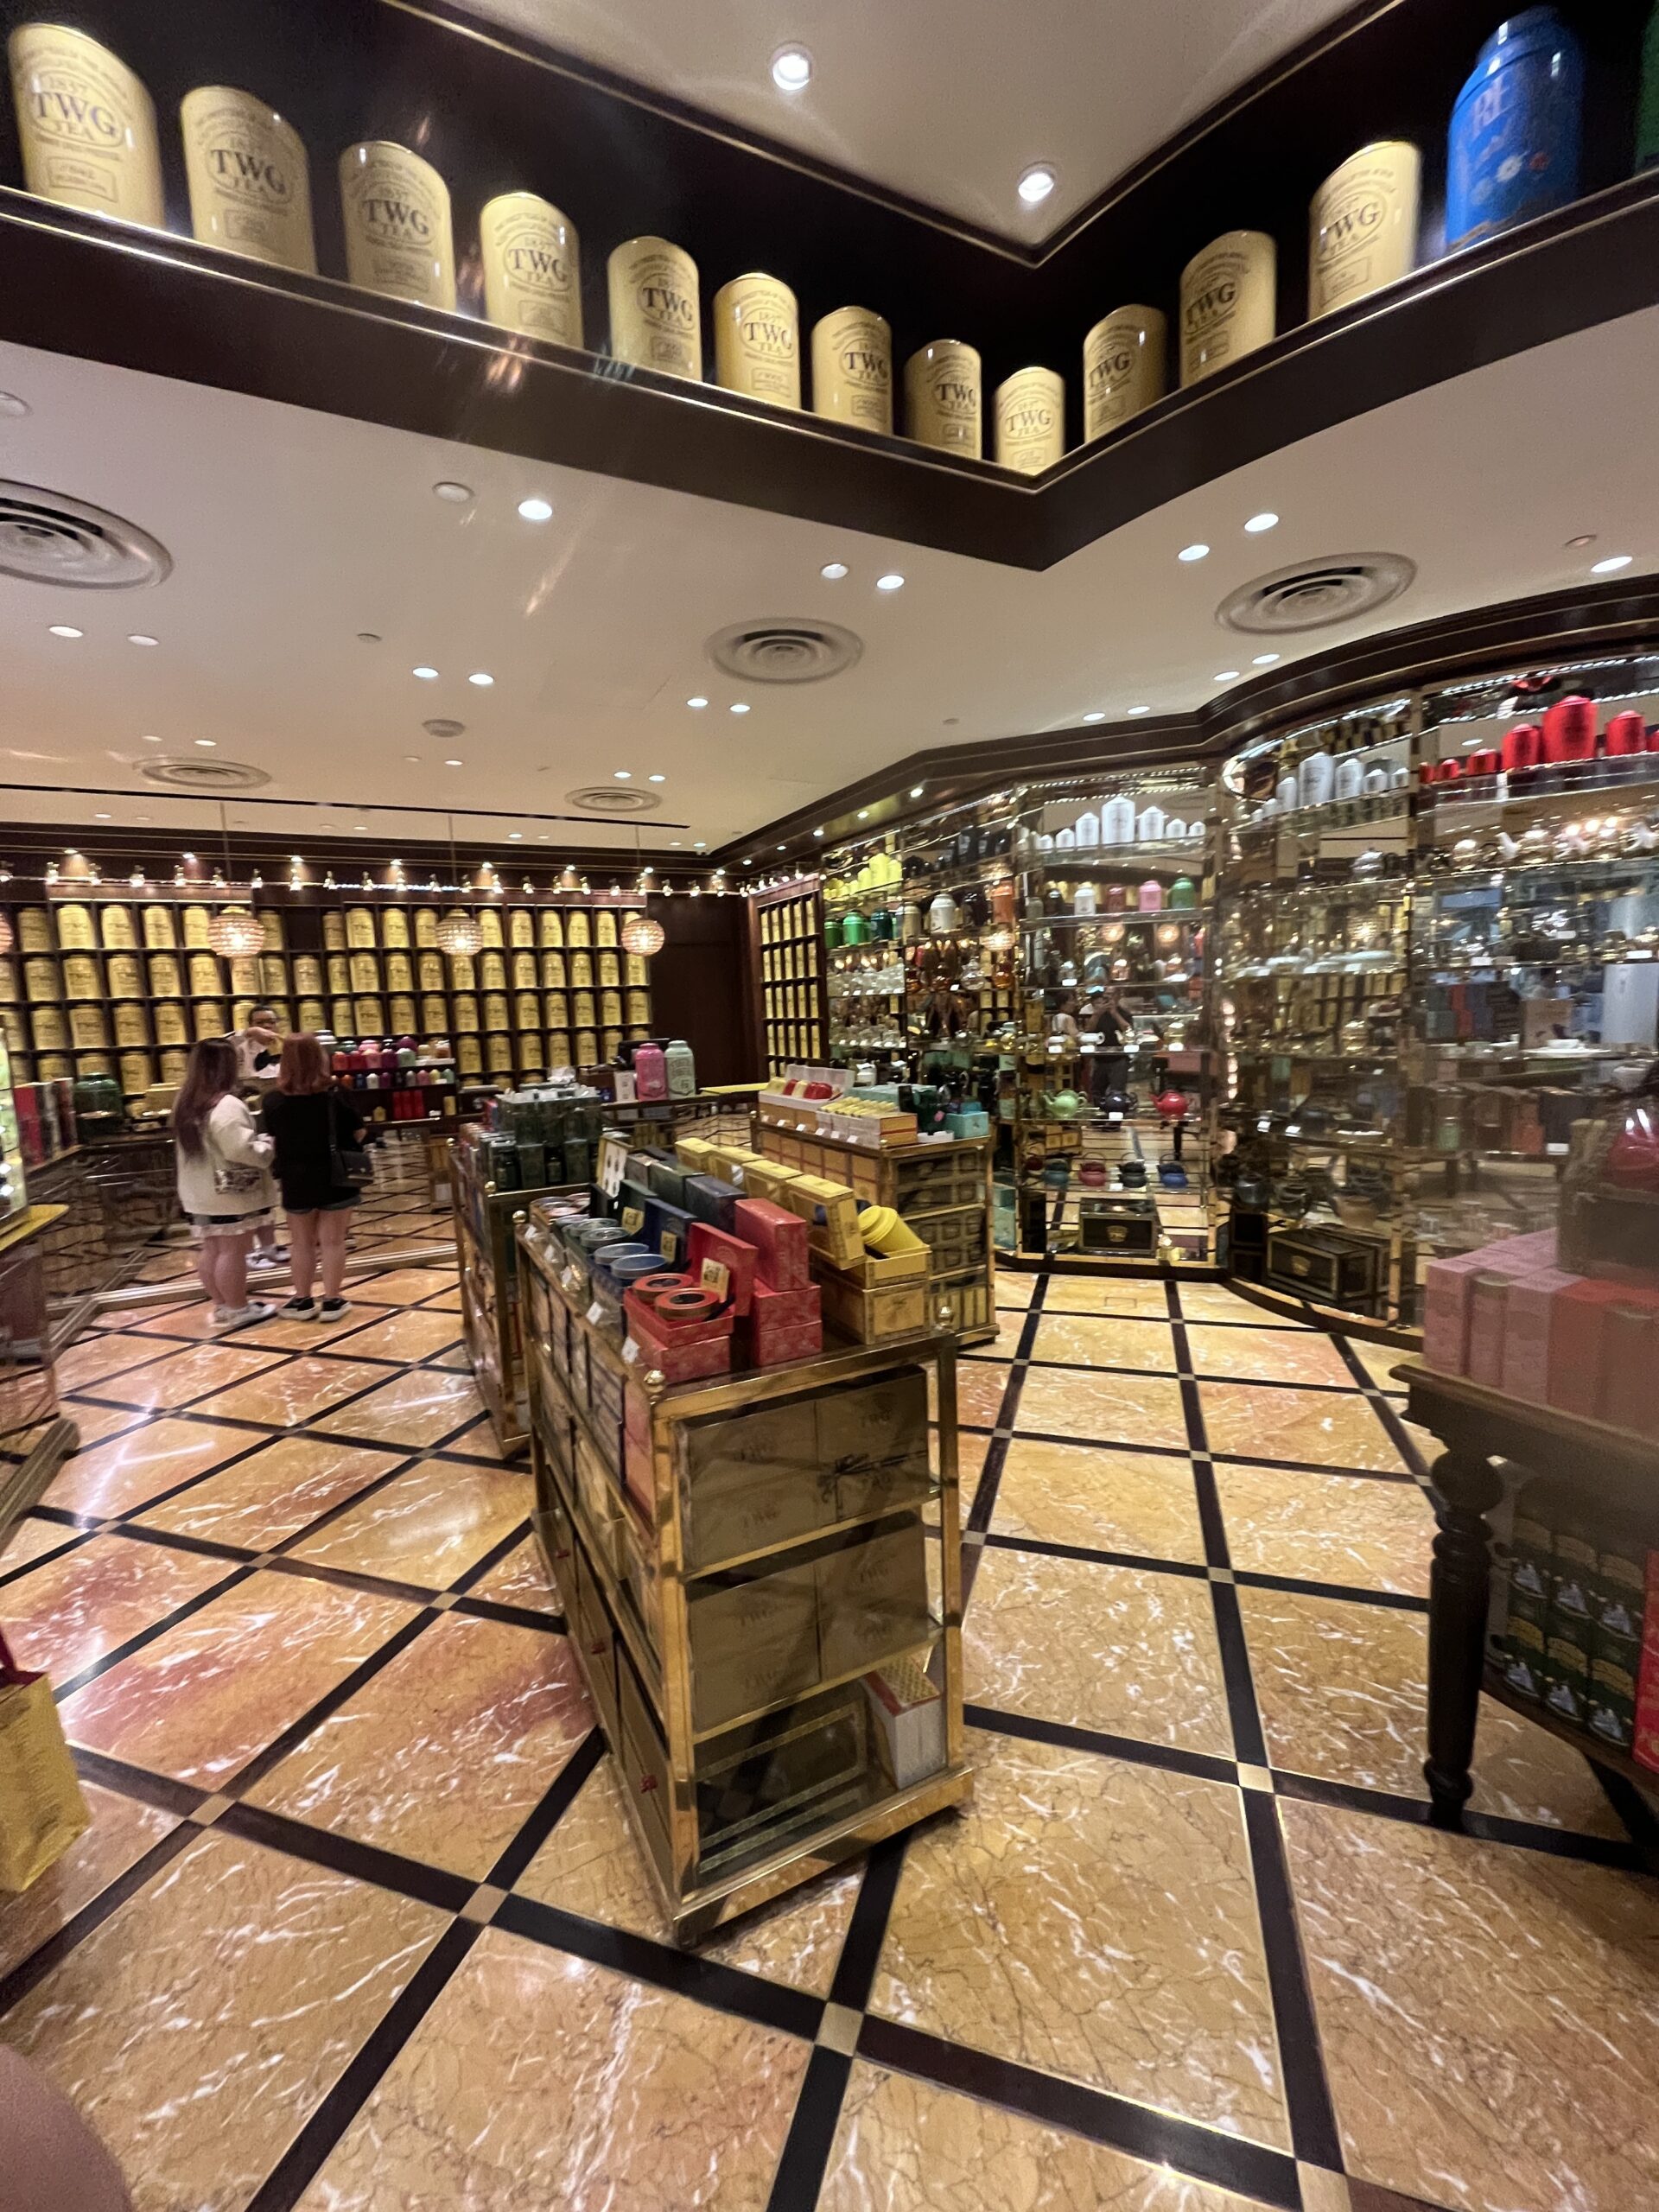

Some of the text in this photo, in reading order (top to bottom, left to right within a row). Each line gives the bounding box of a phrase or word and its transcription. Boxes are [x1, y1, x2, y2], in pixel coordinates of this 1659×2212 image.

[35, 91, 117, 138] TWG
[210, 149, 286, 195] TWG
[362, 198, 430, 236] TWG
[507, 247, 569, 283] TWG
[641, 286, 694, 322] TWG
[1185, 282, 1236, 327] TWG
[743, 321, 793, 351] TWG
[843, 351, 889, 379] TWG
[1089, 351, 1130, 389] TWG
[935, 383, 977, 408] TWG
[1005, 408, 1052, 433] TWG
